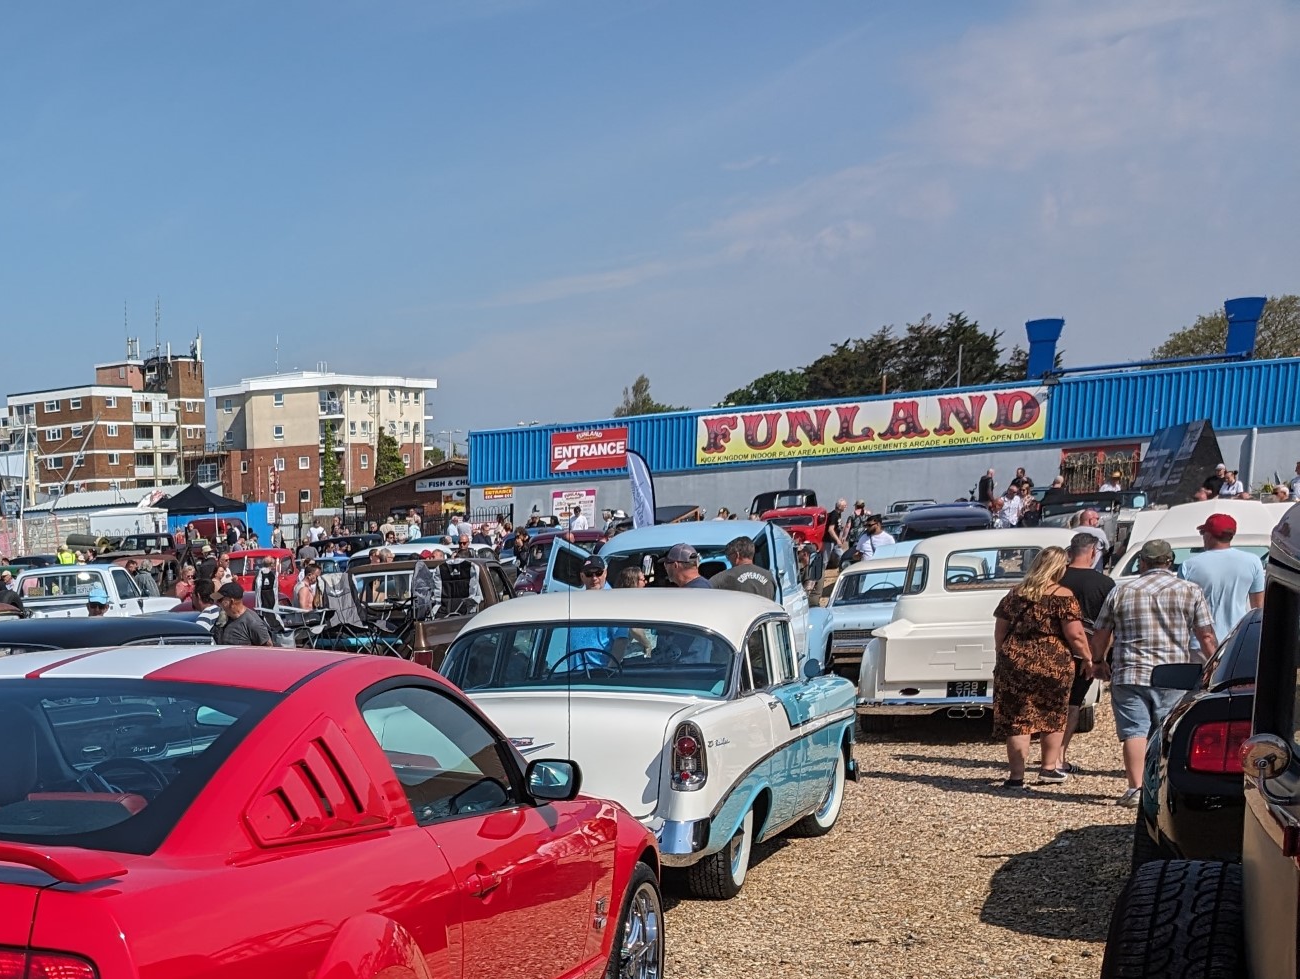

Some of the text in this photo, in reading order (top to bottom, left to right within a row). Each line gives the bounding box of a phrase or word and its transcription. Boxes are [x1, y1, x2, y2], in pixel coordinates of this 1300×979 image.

[701, 391, 1041, 454] FUNLAND
[554, 441, 625, 459] ENTRANCE
[717, 453, 749, 461] KINGDOM
[750, 452, 777, 460] INDOOR
[778, 450, 797, 458] PLAY
[822, 444, 856, 453] FUNLAND
[856, 441, 908, 451] AMUSEMENTS
[908, 439, 940, 448] ARCADE
[948, 436, 984, 444] BOWLING
[428, 480, 446, 488] FISH
[737, 572, 768, 585] COPPERFISH
